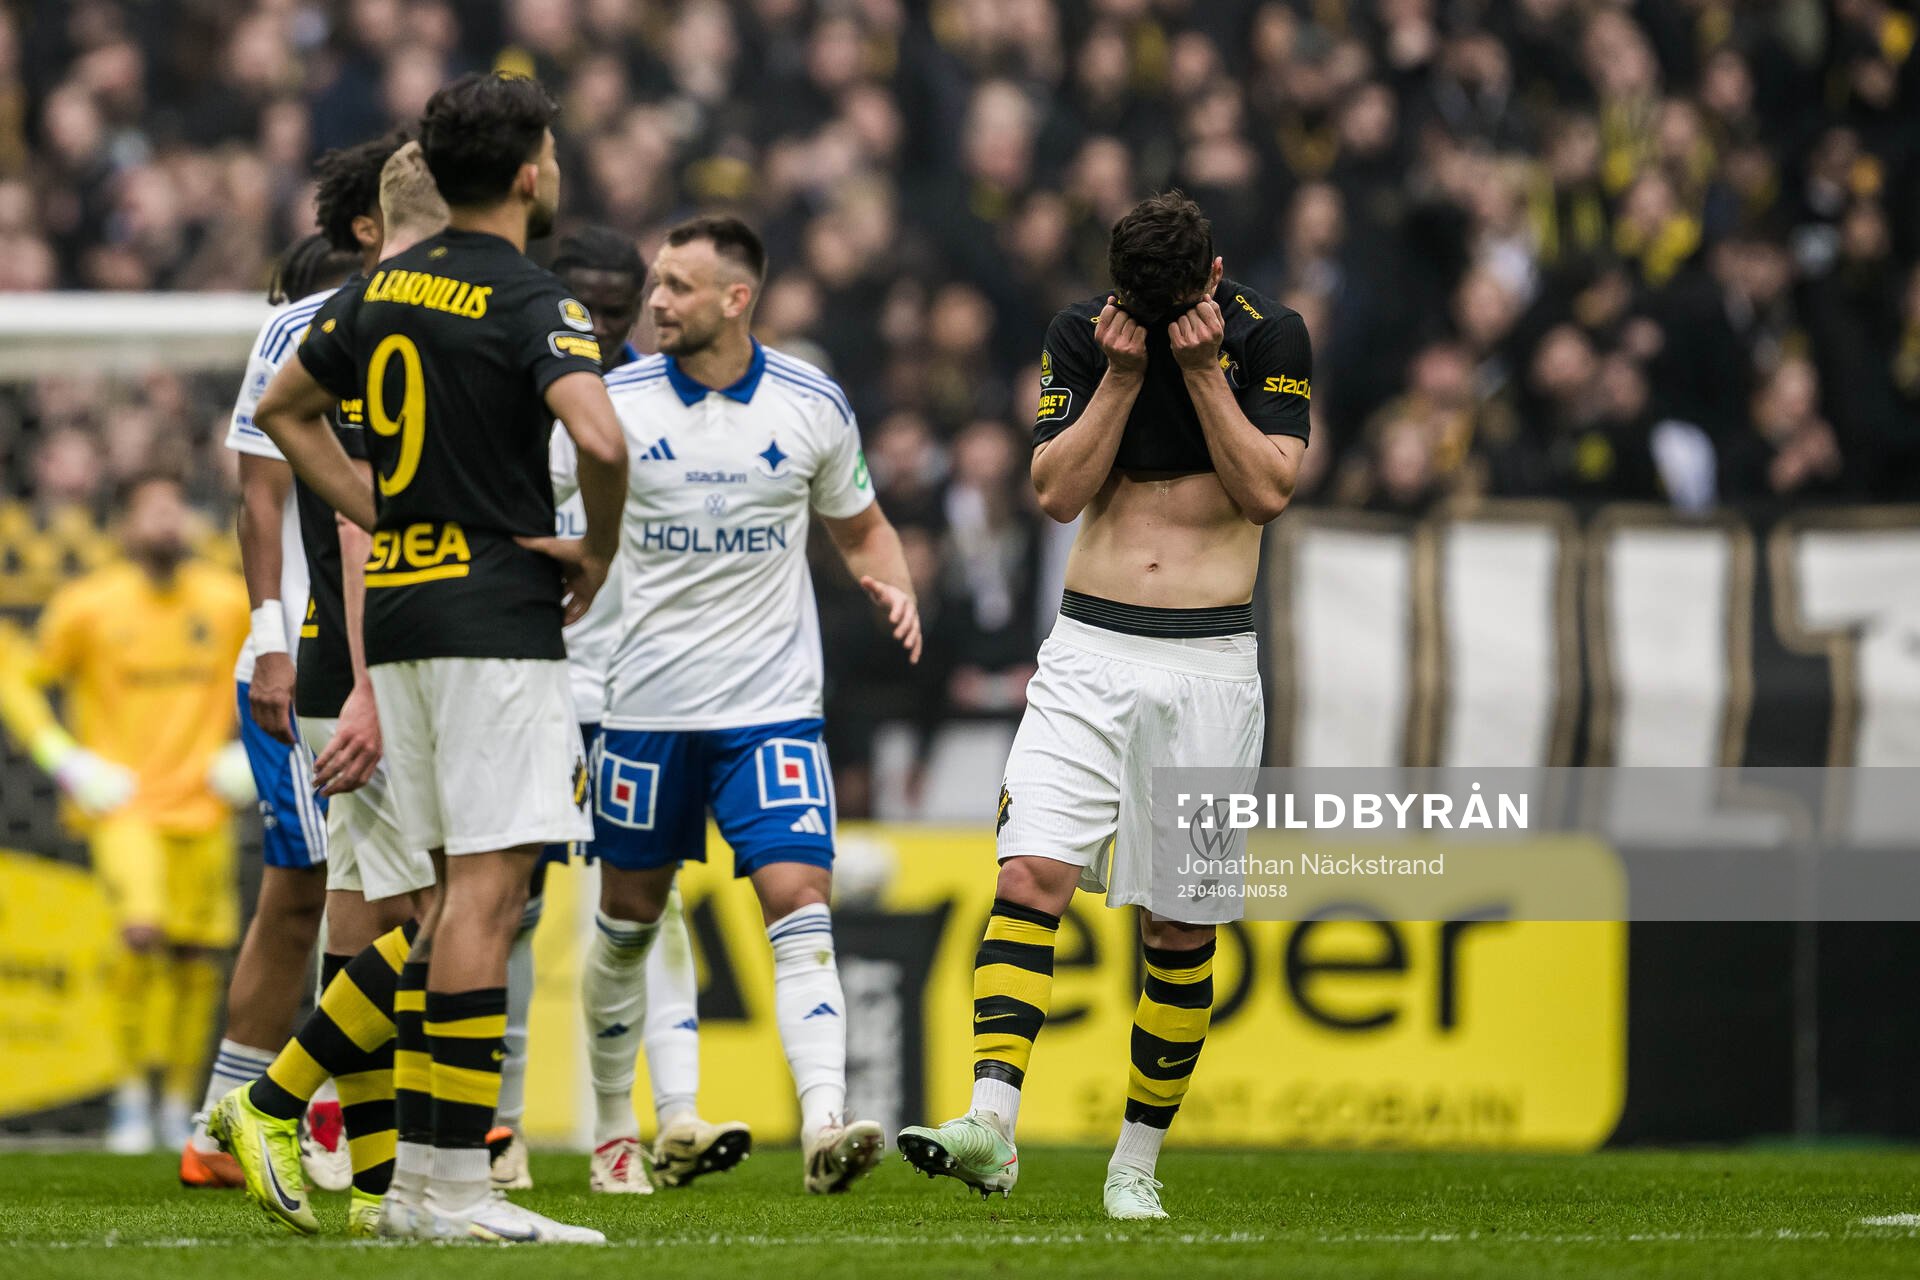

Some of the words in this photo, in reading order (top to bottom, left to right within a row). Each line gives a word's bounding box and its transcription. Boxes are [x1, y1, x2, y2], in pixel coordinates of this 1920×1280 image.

[366, 333, 426, 497] 9
[685, 469, 748, 484] stadium
[643, 523, 787, 553] HOLMEN
[945, 890, 1514, 1035] eber
